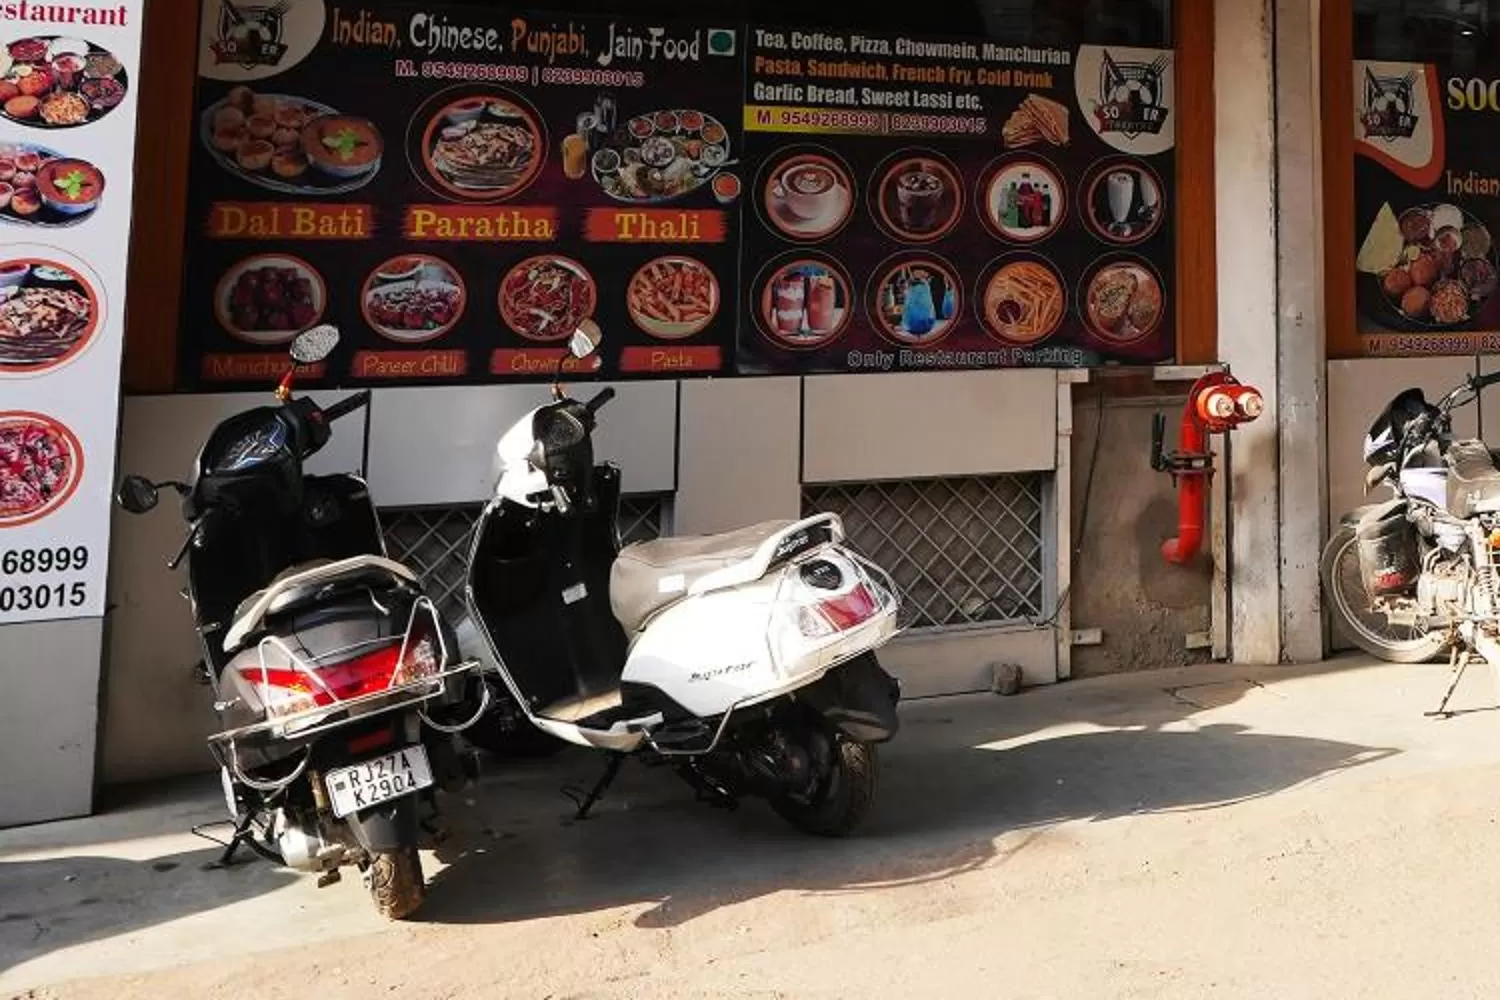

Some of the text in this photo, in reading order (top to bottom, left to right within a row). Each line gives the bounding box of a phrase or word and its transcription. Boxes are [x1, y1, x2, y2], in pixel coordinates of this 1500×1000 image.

[0, 0, 127, 26] staurant
[597, 22, 642, 66] Jain
[648, 27, 701, 61] Food
[755, 30, 787, 50] Tea,
[791, 33, 847, 53] Coffee,
[982, 43, 1072, 65] Manchurian
[892, 63, 945, 83] French
[977, 68, 1011, 85] Cold
[1014, 70, 1053, 89] Drink
[754, 82, 803, 102] Garlic
[861, 88, 909, 108] Sweet
[912, 91, 952, 110] Lassi
[956, 93, 983, 111] etc.
[219, 208, 365, 238] Dal Bati
[409, 210, 554, 241] Paratha
[614, 212, 701, 240] Thali
[847, 349, 895, 370] Only
[898, 348, 1008, 367] Restaurant
[2, 545, 88, 574] 68999
[0, 582, 86, 611] 03015
[347, 752, 411, 788] RJ27A
